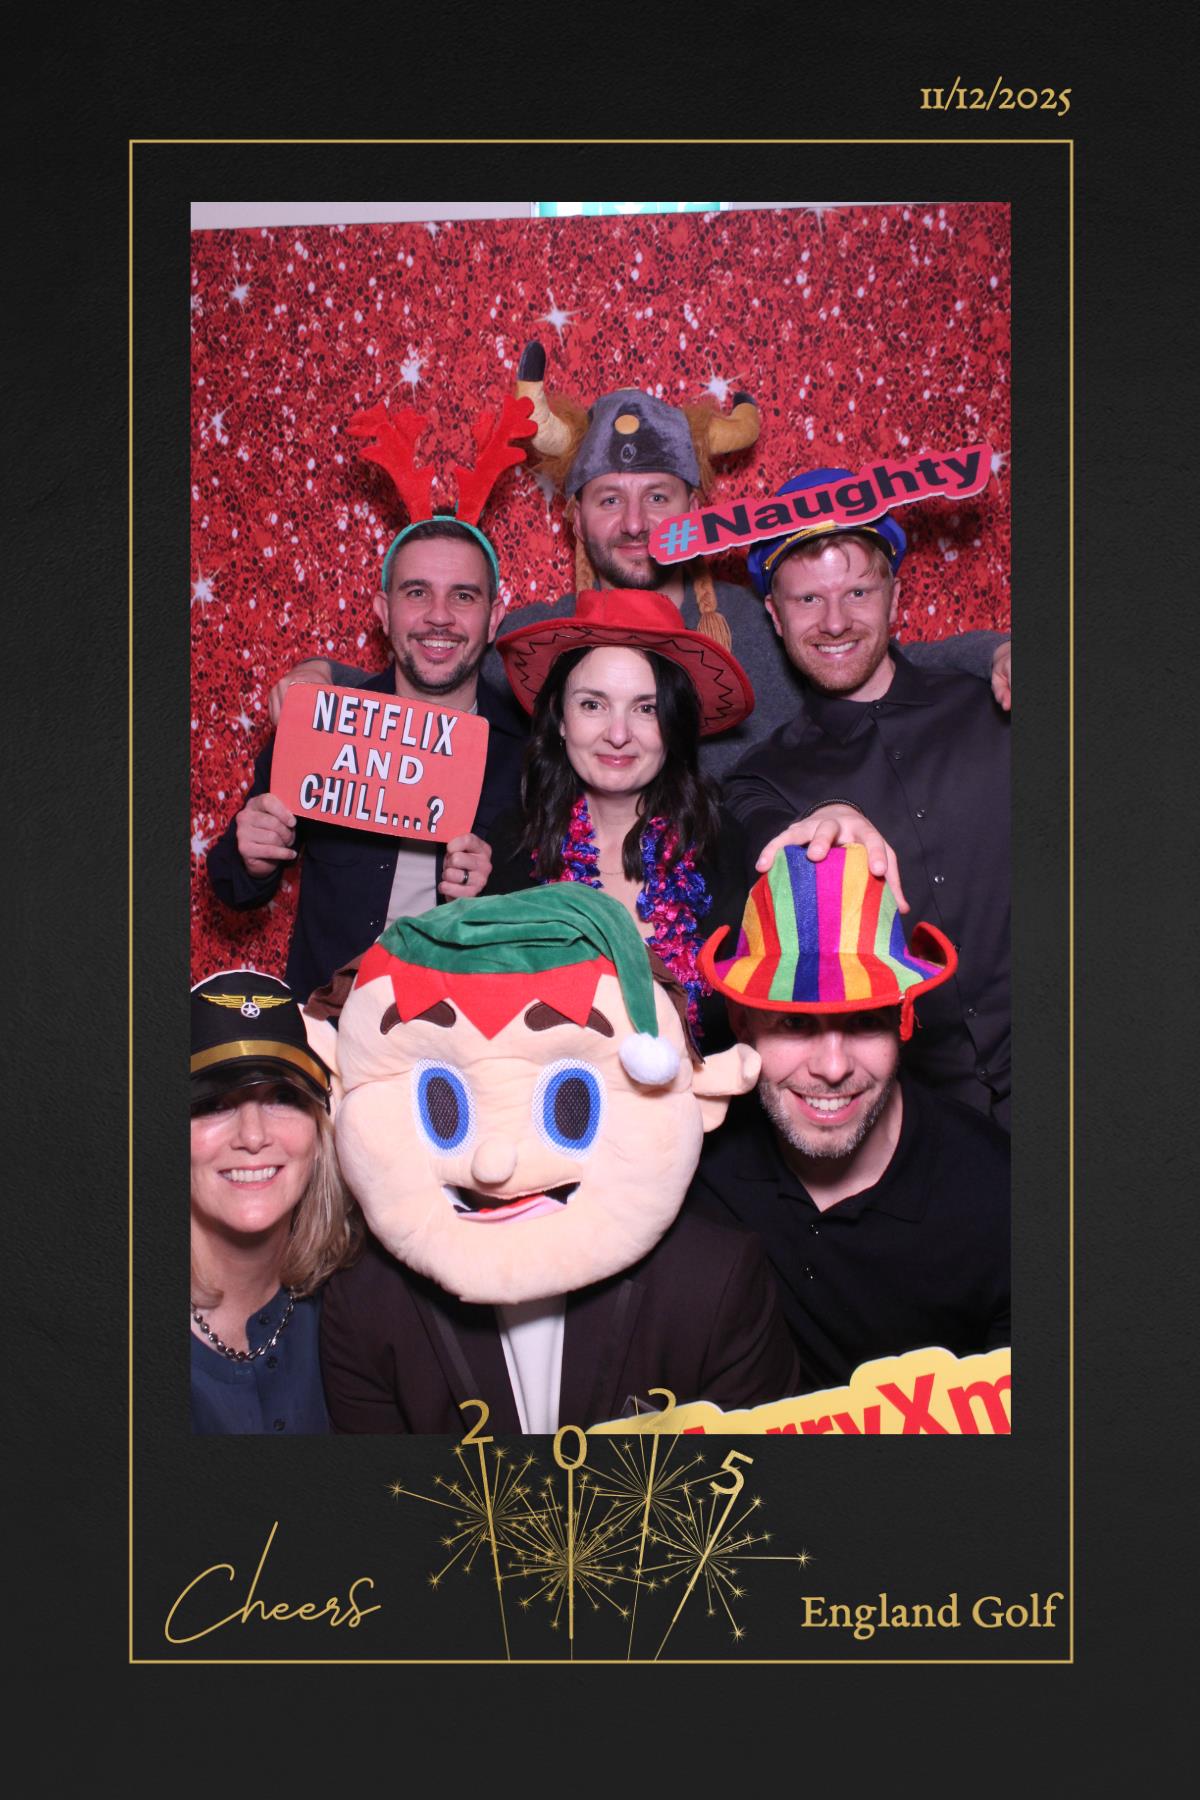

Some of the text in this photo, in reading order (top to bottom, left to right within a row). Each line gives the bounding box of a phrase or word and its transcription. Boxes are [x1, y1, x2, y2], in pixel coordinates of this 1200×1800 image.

[659, 451, 981, 555] #Naughty
[312, 689, 458, 756] NETFLIX
[331, 743, 425, 785] AND
[300, 773, 445, 834] CHILL...?
